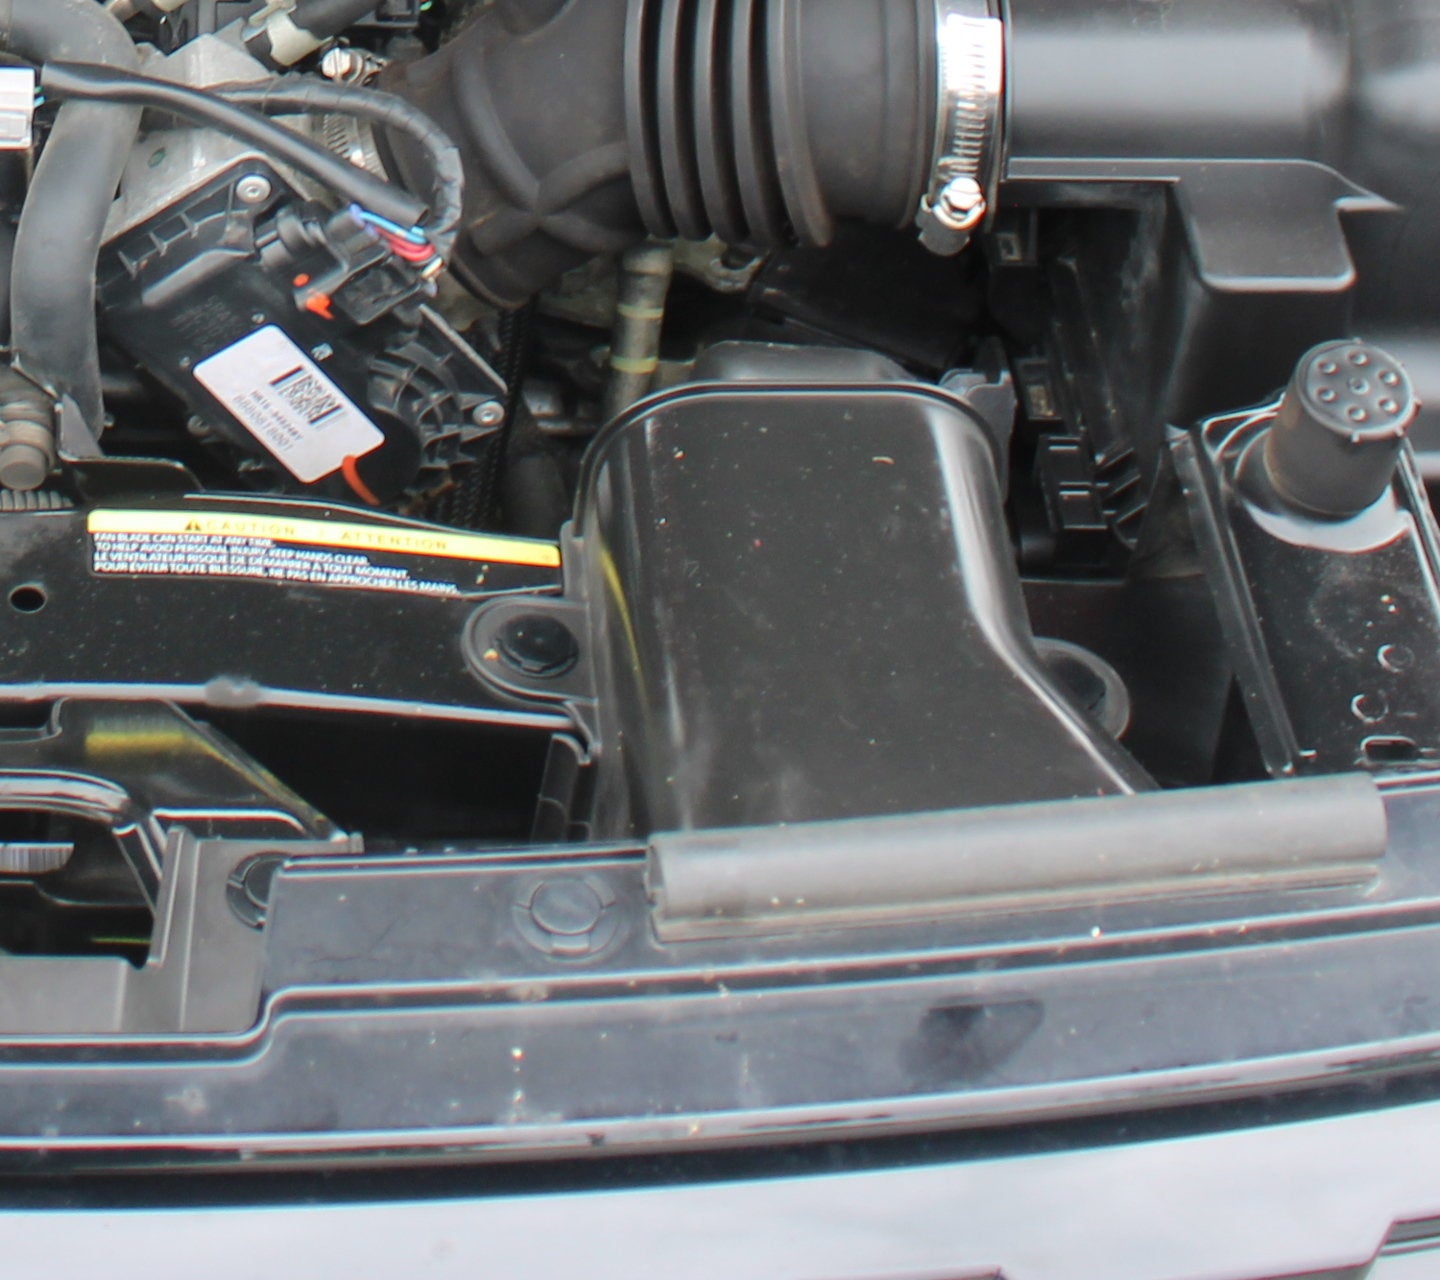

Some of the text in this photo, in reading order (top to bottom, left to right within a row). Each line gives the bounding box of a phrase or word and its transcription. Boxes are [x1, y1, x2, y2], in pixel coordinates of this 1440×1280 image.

[94, 533, 116, 542] FAN
[117, 533, 151, 542] BLADE
[152, 533, 176, 543] CAN
[177, 534, 208, 544] START
[210, 535, 223, 545] AT
[224, 536, 247, 546] ANY
[206, 519, 448, 550] CAUTION ATTENTION
[94, 552, 109, 561] LE
[109, 552, 186, 563] VENTILATEUR
[186, 553, 229, 565] RISQUE
[230, 555, 246, 565] DE
[322, 562, 353, 574] TOUT
[95, 542, 111, 552] TO
[112, 542, 139, 552] HELP
[140, 543, 173, 553] AVOID
[175, 543, 229, 555] PERSONAL
[269, 548, 296, 558] KEEP
[296, 550, 333, 562] HANDS
[94, 561, 129, 572] POUR
[170, 562, 207, 574] TOUTE
[269, 568, 285, 578] NE
[286, 569, 309, 580] PAS
[309, 571, 326, 582] EN
[327, 572, 398, 588] APPROCHER
[398, 579, 418, 590] LES
